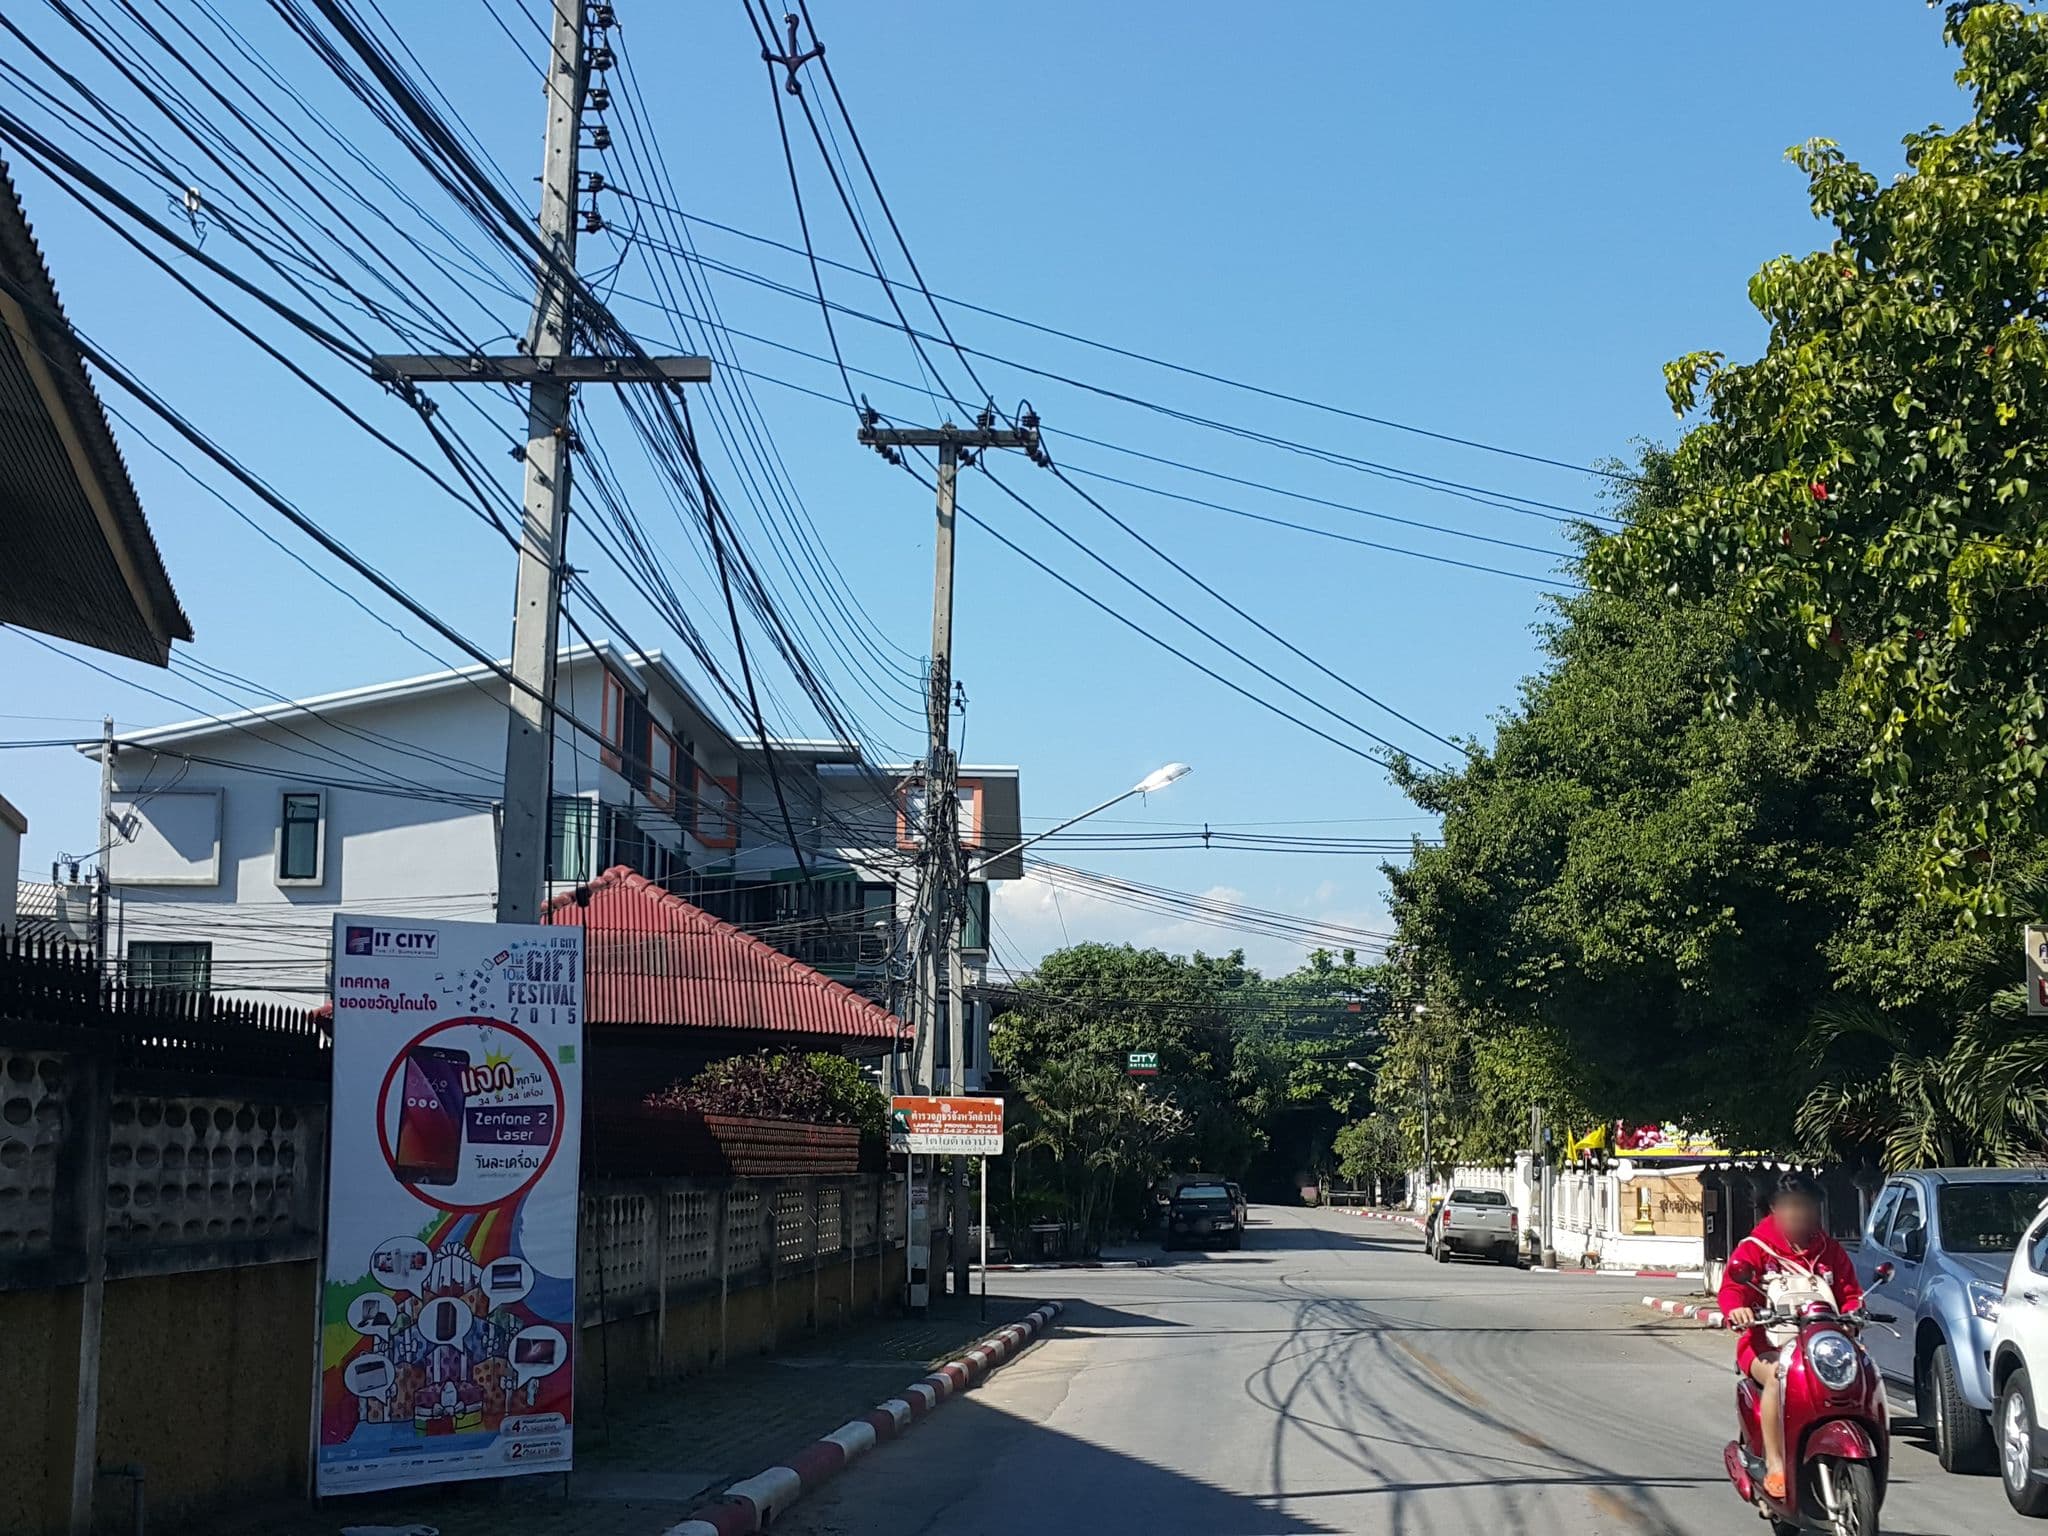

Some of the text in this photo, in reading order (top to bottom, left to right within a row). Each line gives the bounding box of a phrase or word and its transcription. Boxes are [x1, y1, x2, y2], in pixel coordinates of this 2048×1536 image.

[374, 931, 436, 949] IT CITY
[550, 937, 577, 948] IT CITY
[526, 949, 579, 983] GIFT
[340, 975, 390, 990] เทศกาล
[508, 982, 577, 1006] FESTIVAL
[339, 992, 438, 1014] ของขวัญโดนใจ
[460, 1062, 513, 1096] แจก
[516, 1073, 542, 1090] ทุกวัน
[478, 1097, 490, 1106] 34
[508, 1092, 519, 1102] 34
[475, 1112, 548, 1126] Zenfone 2
[496, 1129, 535, 1141] Laser
[475, 1148, 539, 1169] วันละเครื่อง
[511, 1419, 521, 1433] 4
[511, 1442, 522, 1459] 2
